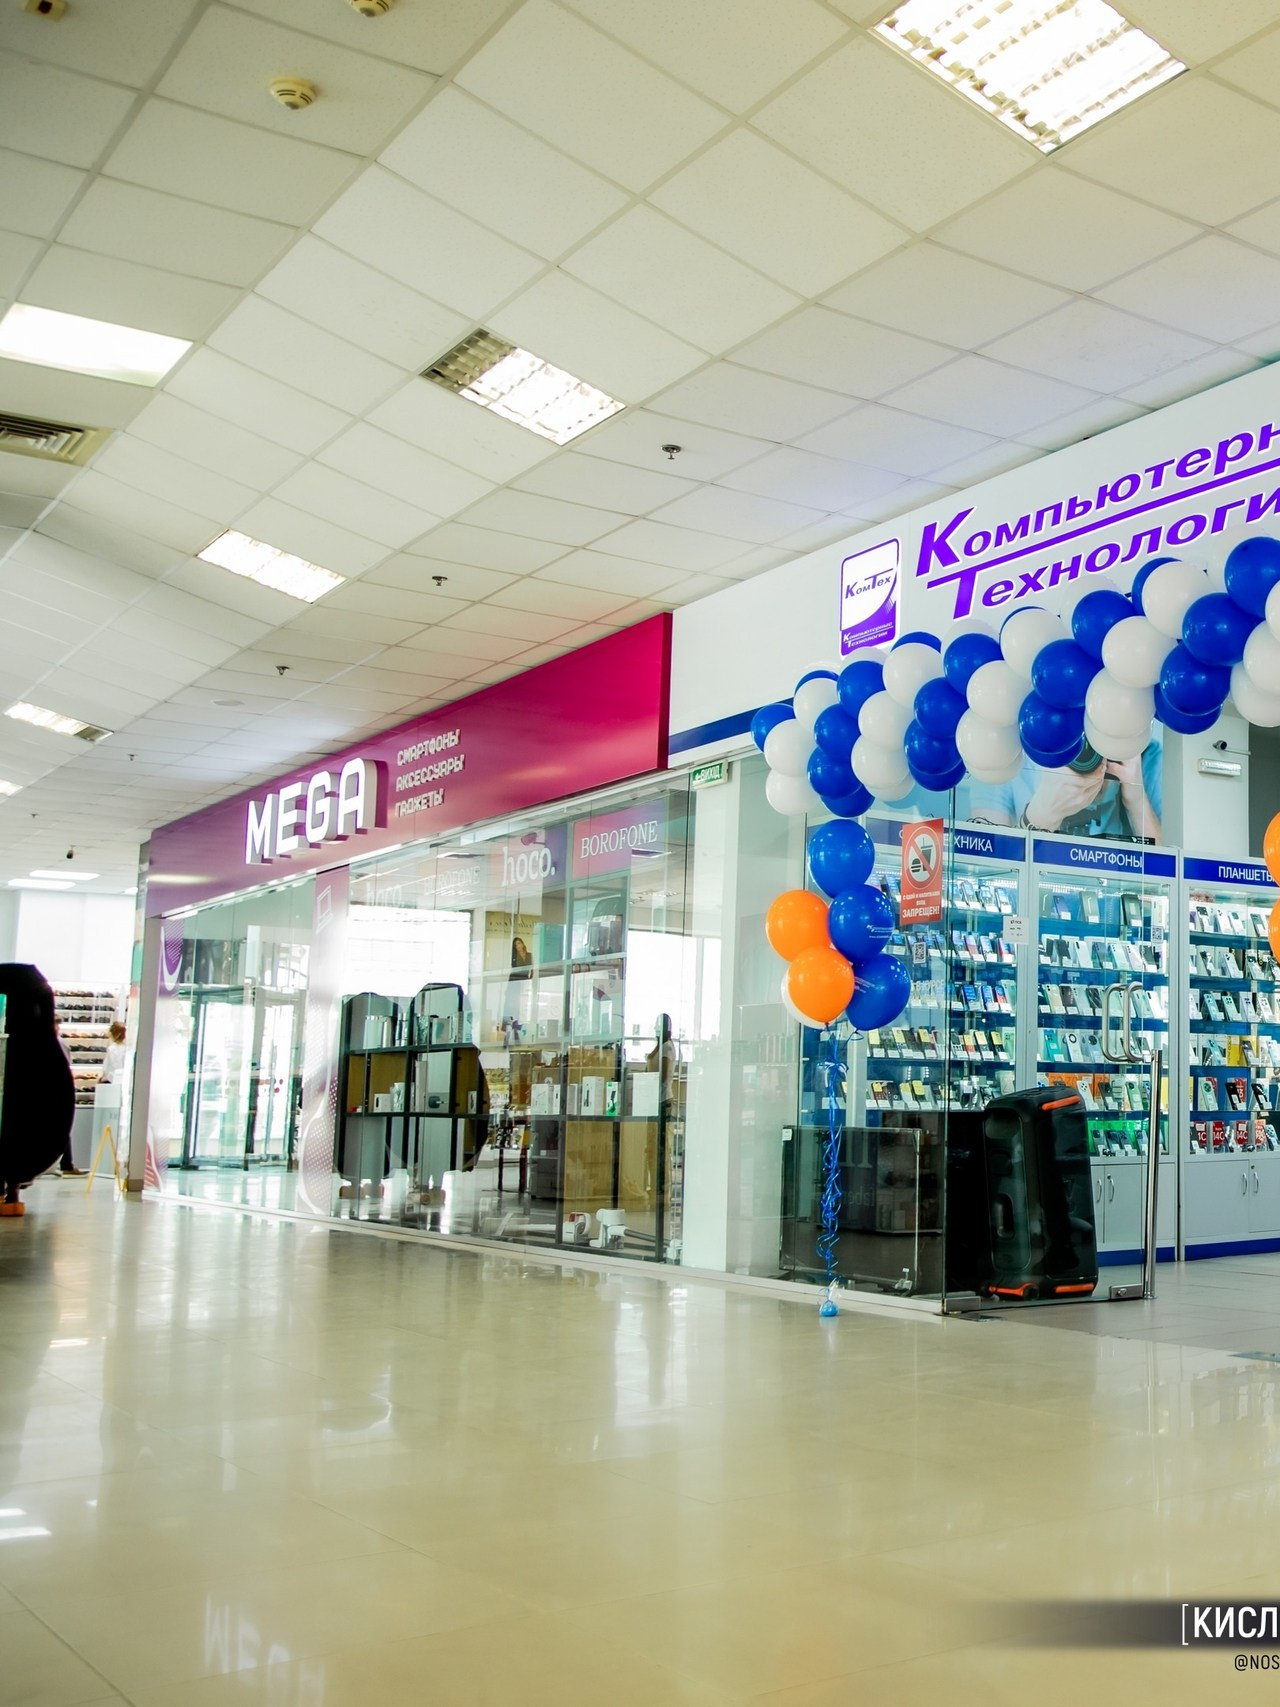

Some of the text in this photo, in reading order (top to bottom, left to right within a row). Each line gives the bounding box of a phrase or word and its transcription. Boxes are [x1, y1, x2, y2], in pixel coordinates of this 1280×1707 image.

[397, 728, 461, 766] СМАРТФОНЫ
[396, 754, 465, 792] АКСЕССУАРЫ
[246, 757, 377, 865] MEGA
[395, 788, 445, 817] ГАДЖЕТЫ
[580, 820, 658, 860] BOROFONE
[1069, 848, 1142, 868] СМАРТФОНЫ
[902, 905, 940, 919] ЗАПРЕЩЕН!
